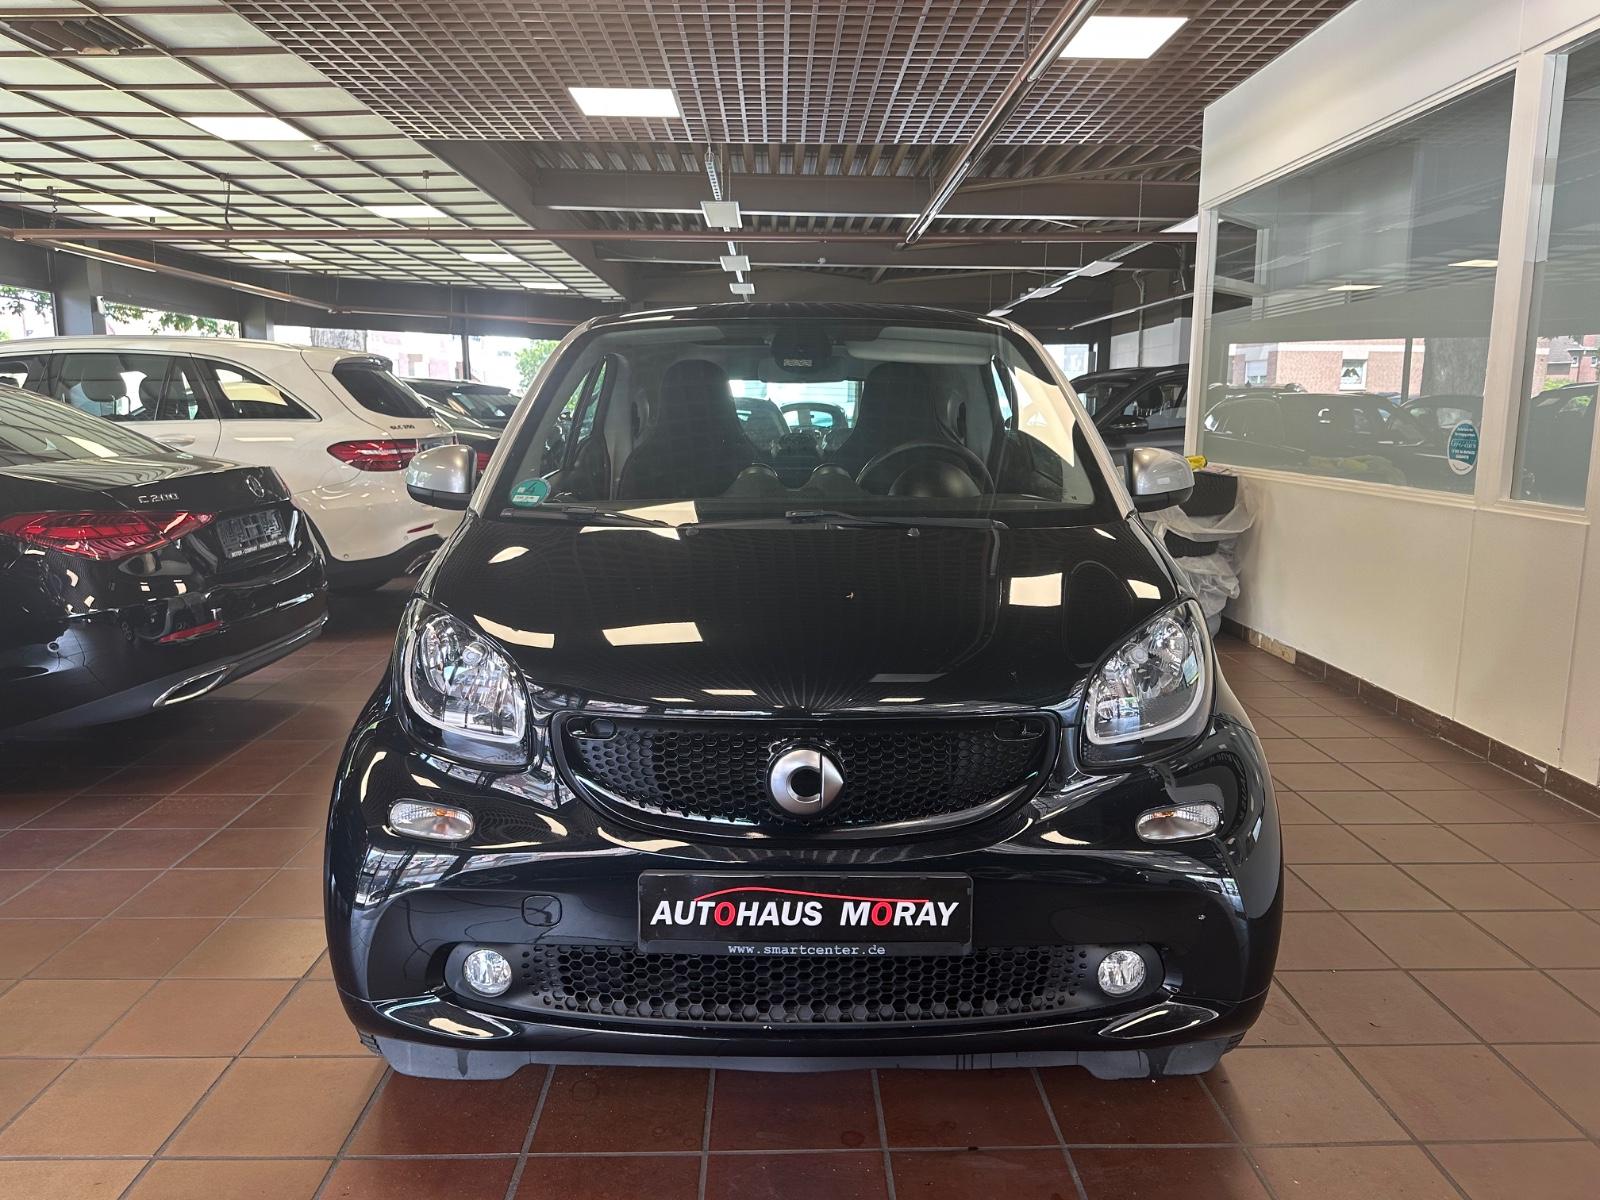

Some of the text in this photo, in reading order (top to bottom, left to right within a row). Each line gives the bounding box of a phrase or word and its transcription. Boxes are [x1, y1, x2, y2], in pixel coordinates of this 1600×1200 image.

[650, 900, 960, 927] AUTOHAUS MORAY
[727, 944, 886, 956] www.smartcenter.de
